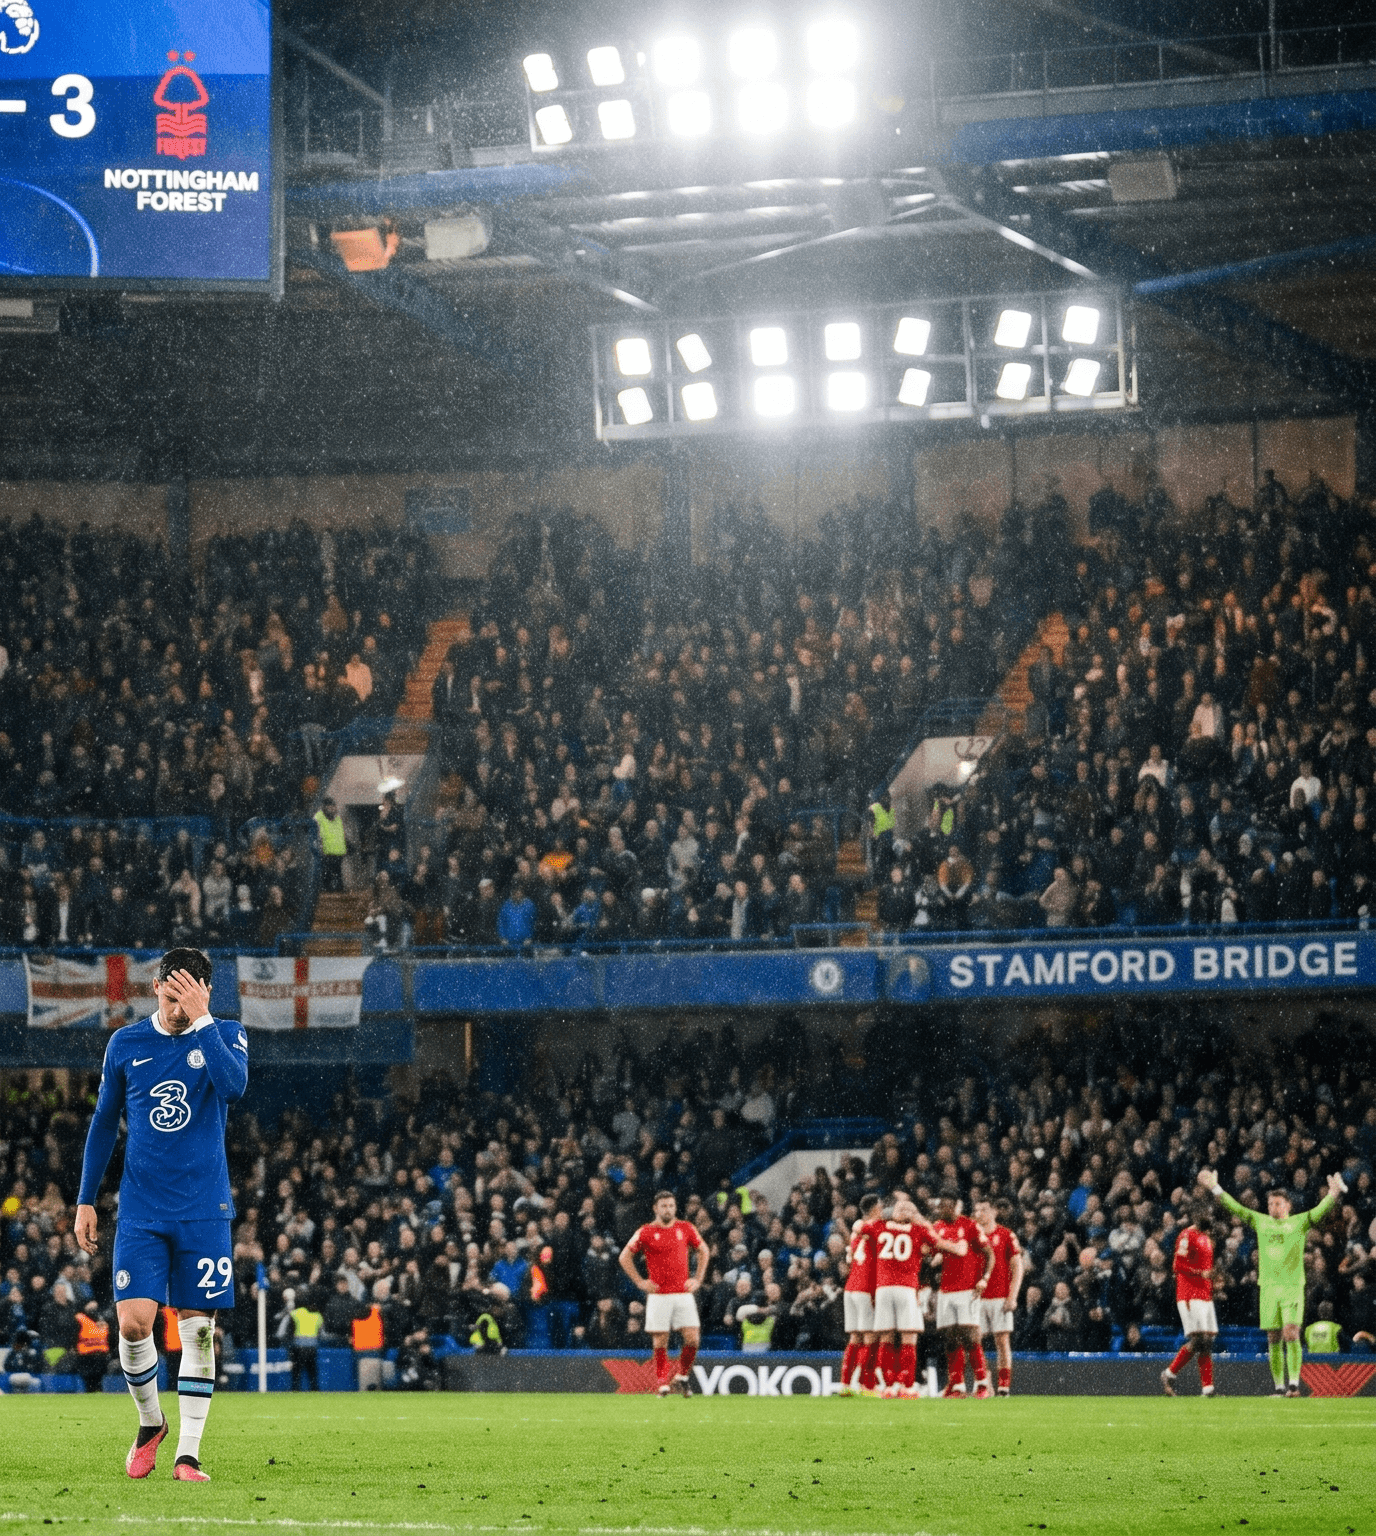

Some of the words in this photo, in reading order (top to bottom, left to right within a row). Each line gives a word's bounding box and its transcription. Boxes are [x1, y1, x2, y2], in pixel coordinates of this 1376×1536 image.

[49, 74, 96, 138] 3
[104, 169, 259, 191] NOTTINGHAM
[137, 191, 226, 212] FOREST
[950, 950, 1175, 988] STAMFORD
[1193, 942, 1359, 980] BRIDGE
[877, 1231, 913, 1262] 20
[197, 1256, 232, 1288] 29
